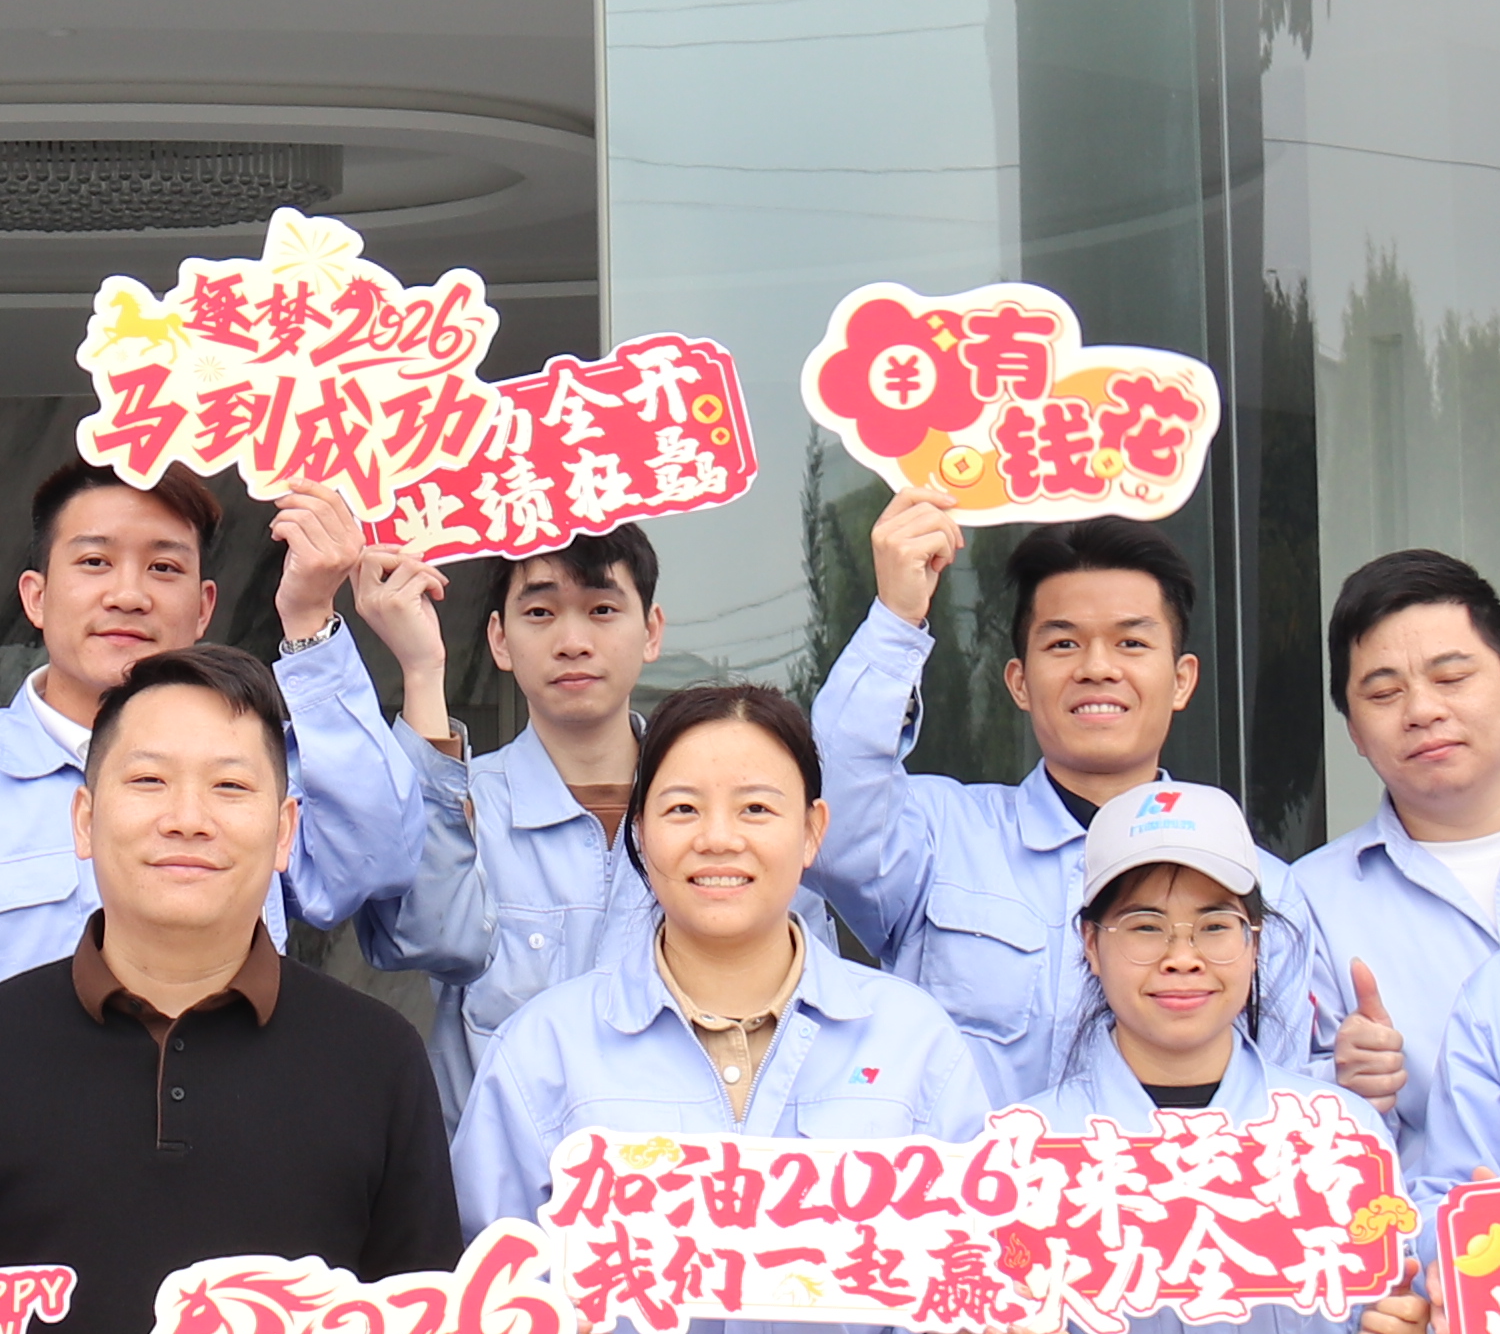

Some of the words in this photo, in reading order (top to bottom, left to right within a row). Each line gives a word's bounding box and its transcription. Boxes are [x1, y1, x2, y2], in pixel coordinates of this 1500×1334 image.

[183, 272, 484, 373] 逐梦2026
[962, 304, 1057, 400] 有
[95, 363, 491, 511] 马到成功
[484, 344, 702, 462] 力全开
[996, 375, 1199, 499] 钱花
[550, 1133, 1019, 1231] 加油2026
[567, 1220, 1027, 1331] 我们一起赢
